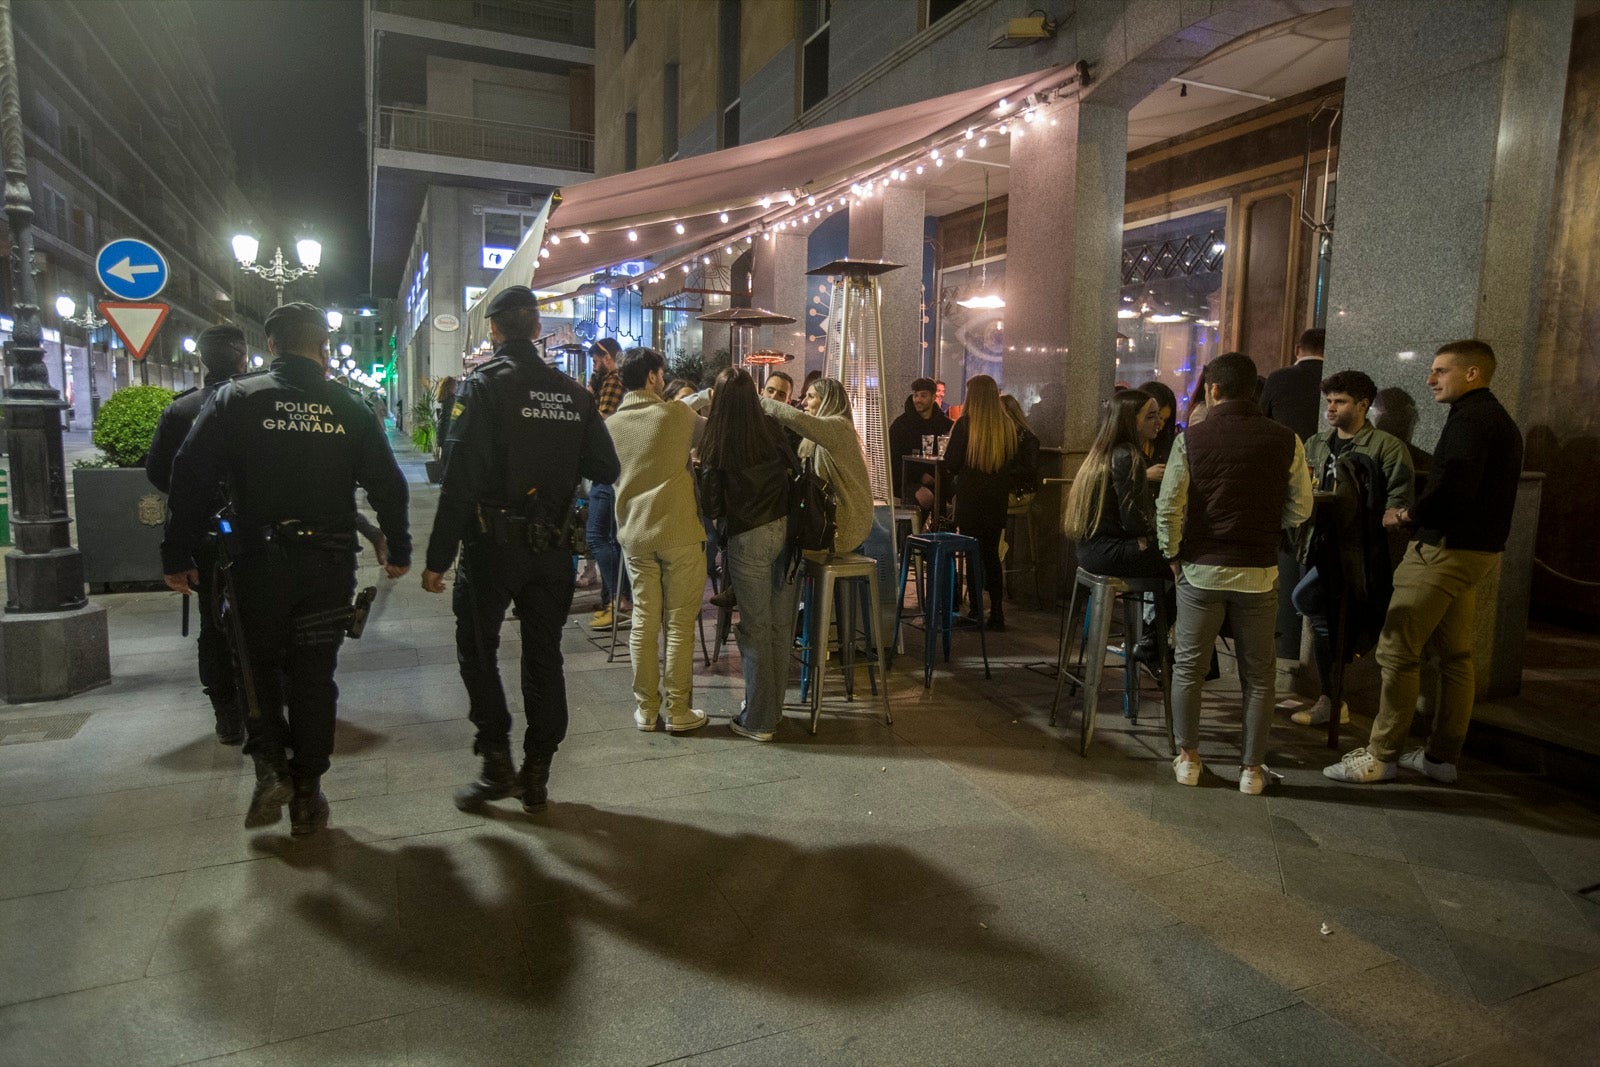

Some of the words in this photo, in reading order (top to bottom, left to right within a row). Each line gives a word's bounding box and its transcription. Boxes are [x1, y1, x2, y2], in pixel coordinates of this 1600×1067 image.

[529, 390, 573, 403] POLICIA
[275, 401, 334, 415] POLICIA
[541, 402, 564, 410] LOCAL
[289, 413, 321, 422] LOCAL
[521, 407, 581, 421] GRANADA
[262, 418, 346, 435] GRANADA
